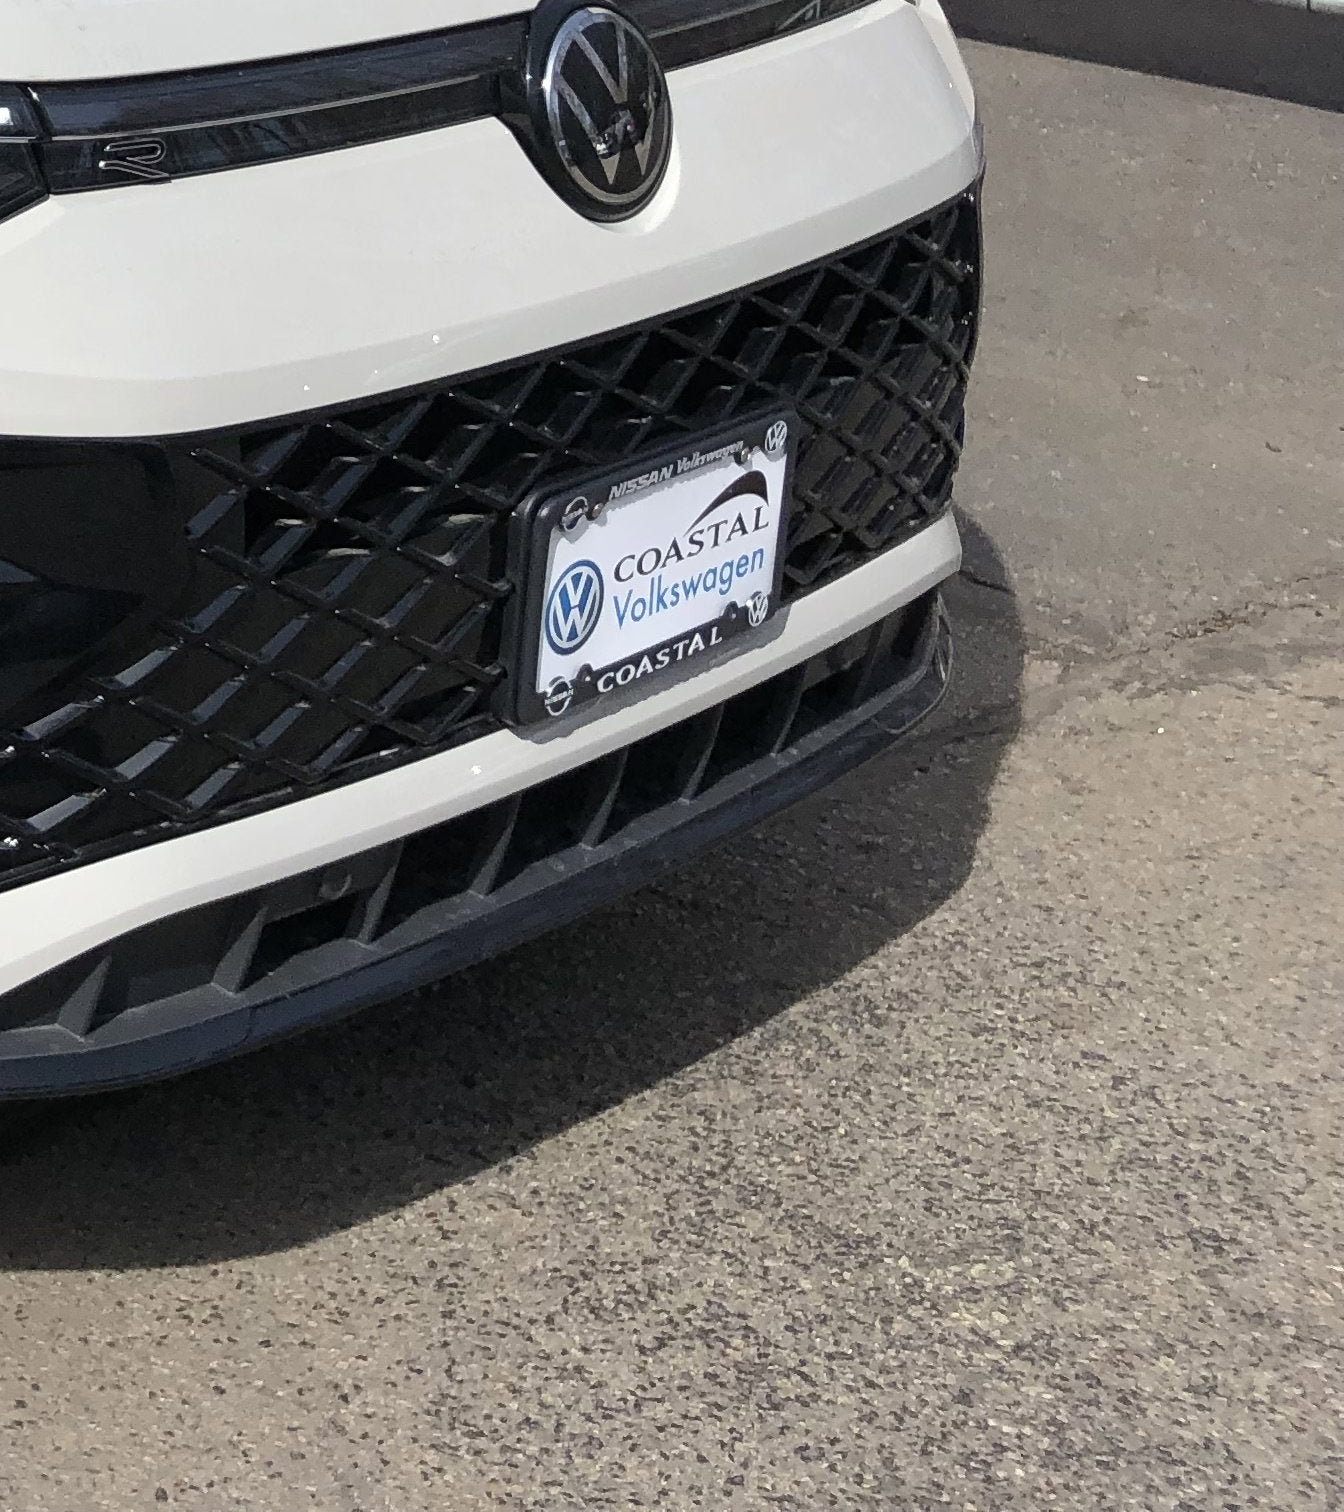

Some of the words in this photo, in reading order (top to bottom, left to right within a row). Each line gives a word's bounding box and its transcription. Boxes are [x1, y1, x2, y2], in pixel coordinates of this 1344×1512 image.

[608, 464, 674, 501] NISSAN
[613, 505, 770, 583] COASTAL
[613, 547, 765, 630] Volkswagen
[597, 625, 723, 693] COASTAL
